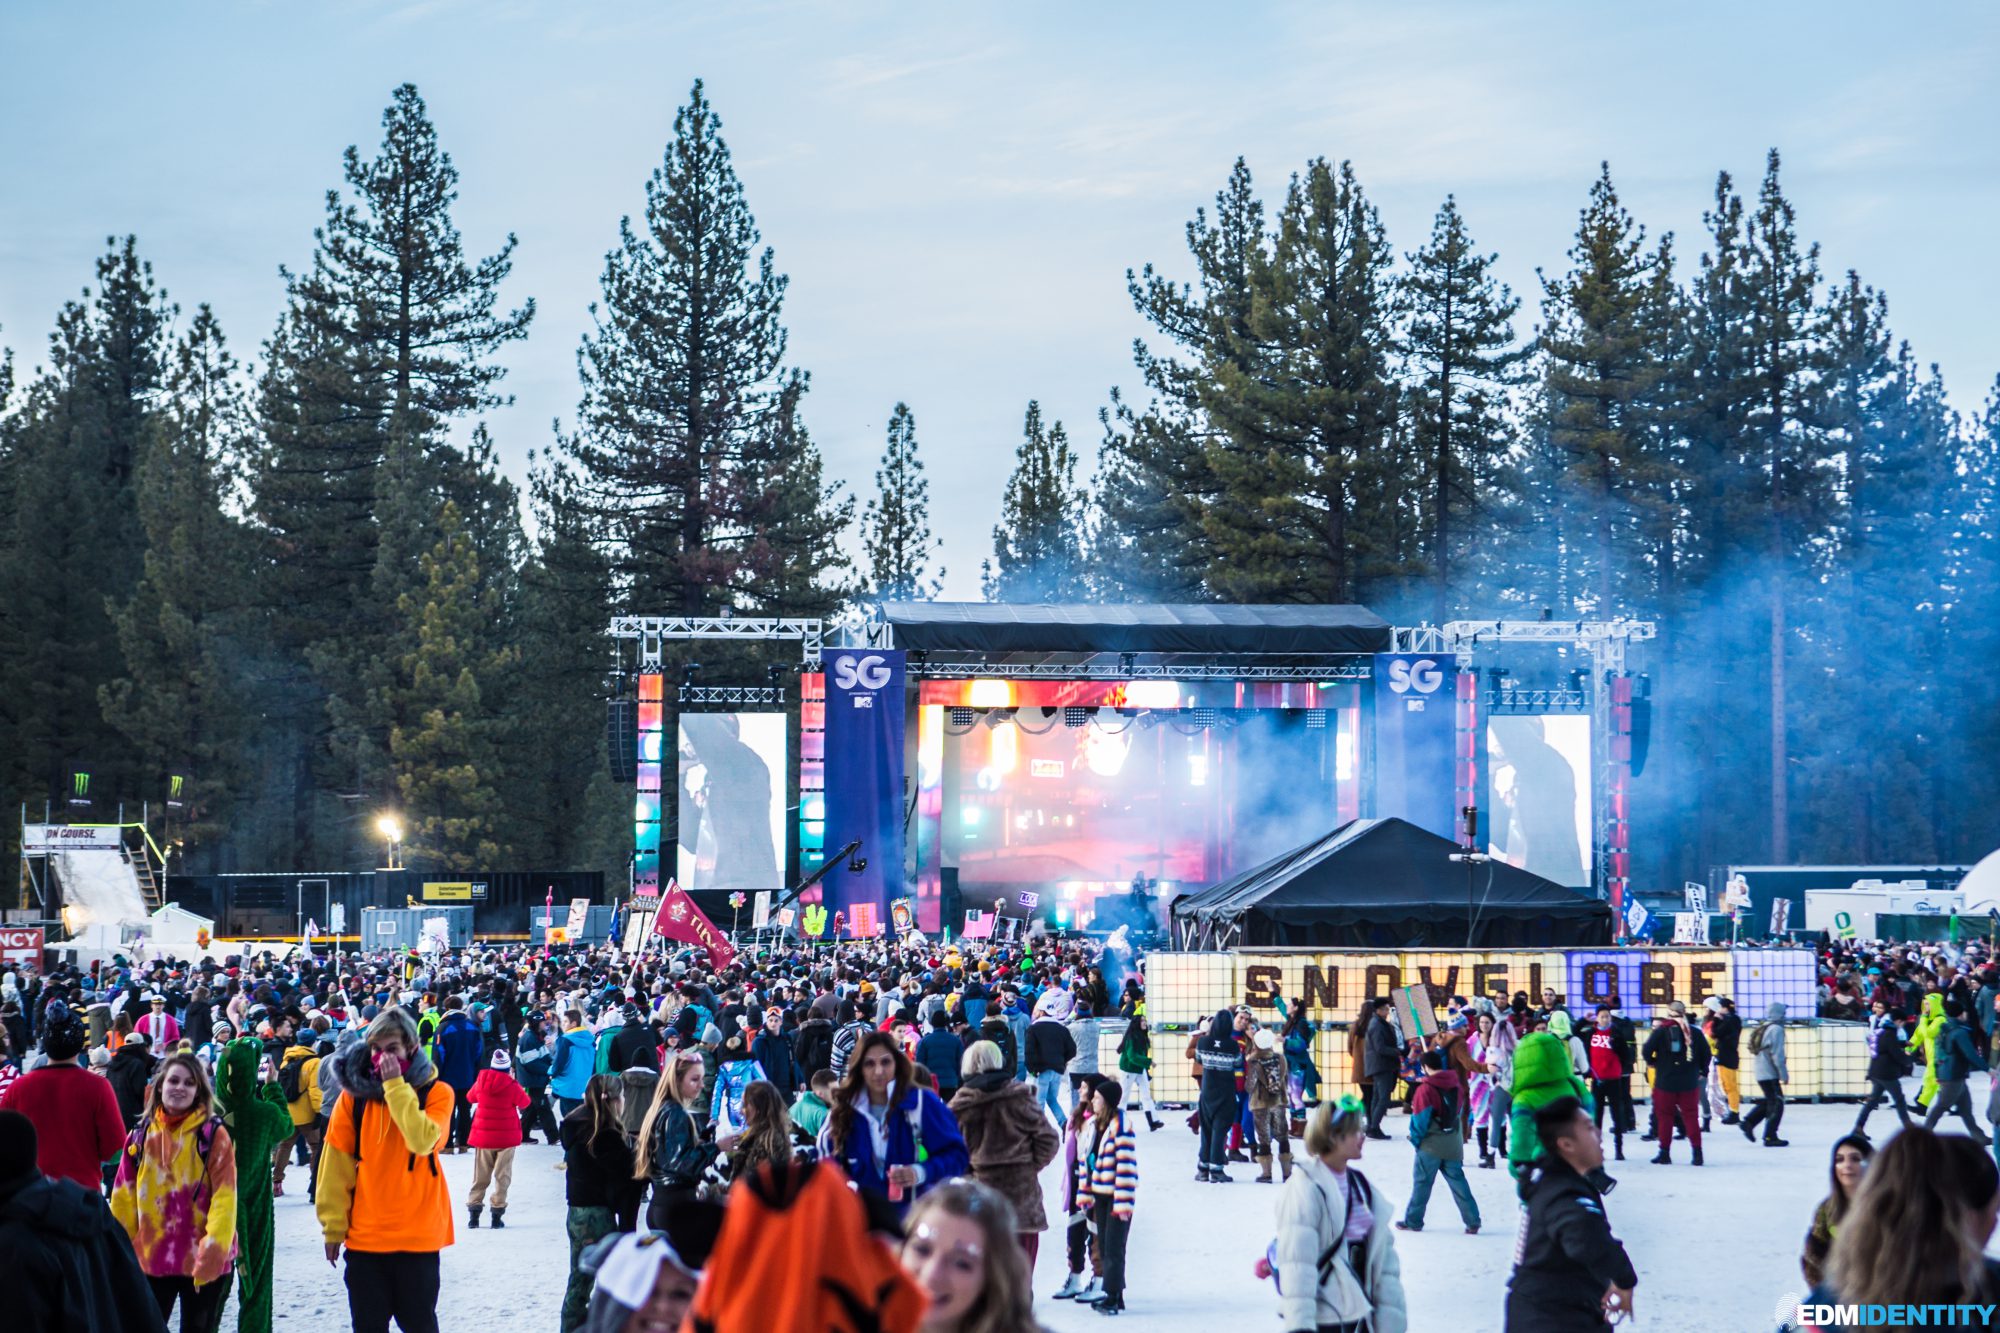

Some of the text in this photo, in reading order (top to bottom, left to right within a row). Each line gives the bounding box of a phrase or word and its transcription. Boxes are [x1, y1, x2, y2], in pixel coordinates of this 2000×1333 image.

[835, 655, 892, 690] SG
[1389, 659, 1443, 694] SG
[472, 885, 486, 893] CAT
